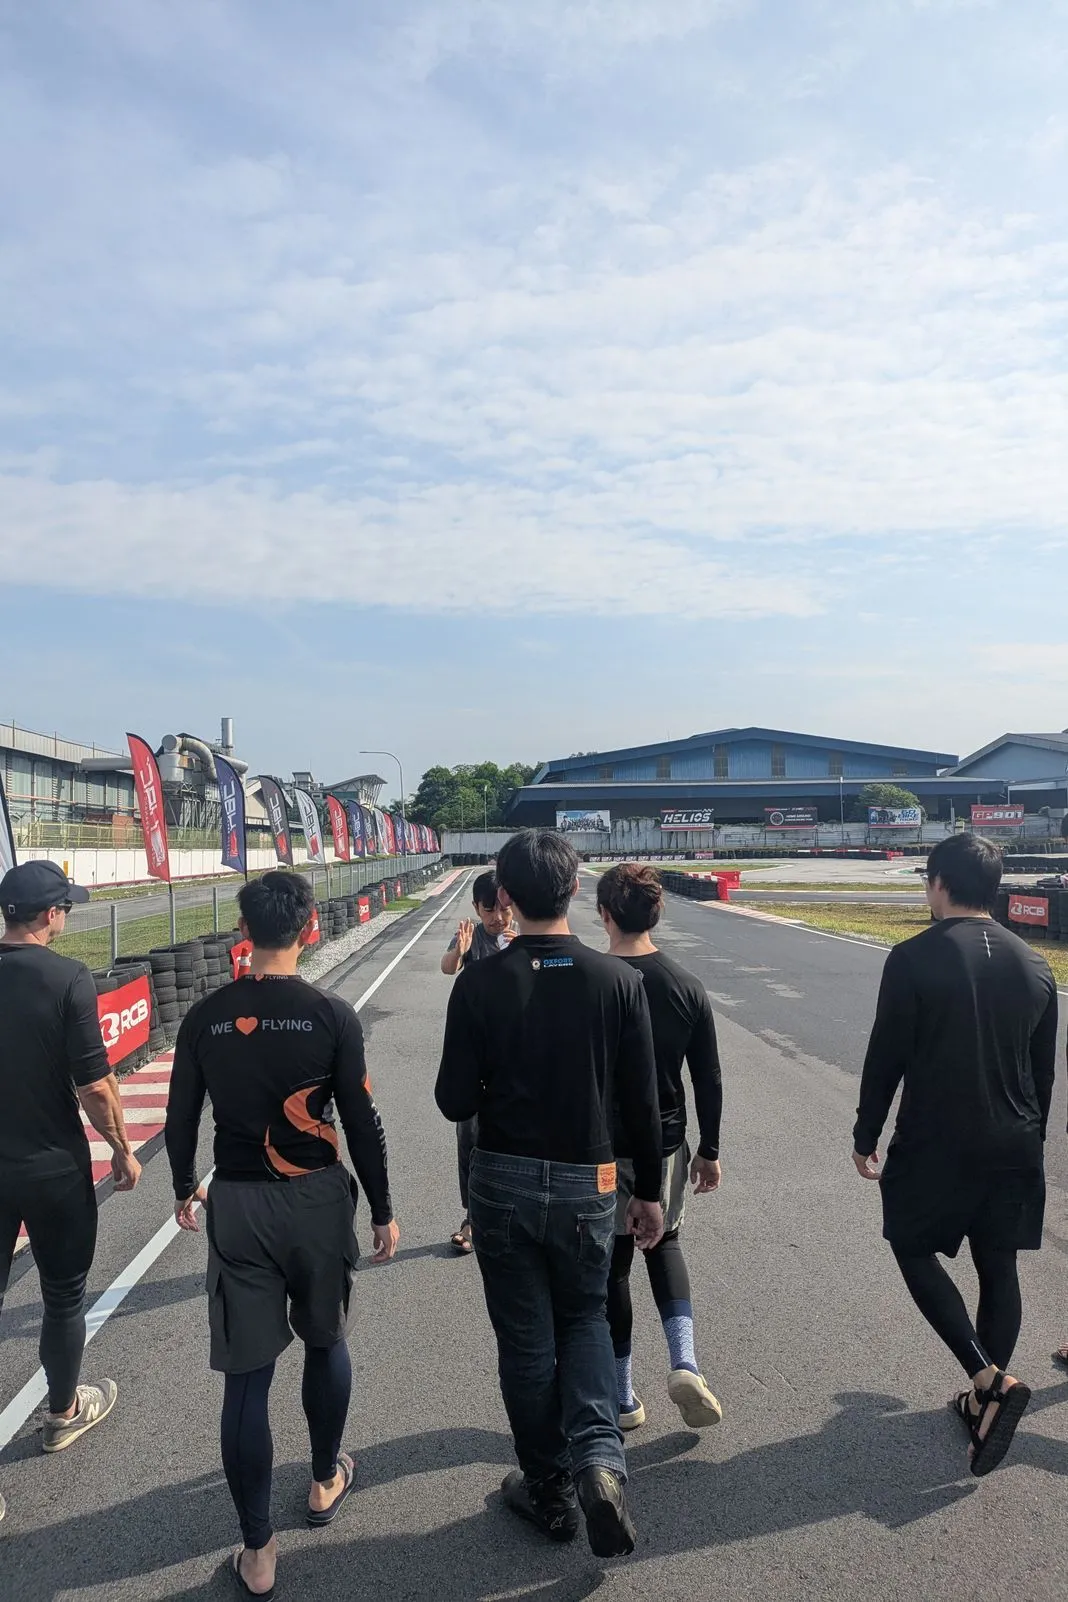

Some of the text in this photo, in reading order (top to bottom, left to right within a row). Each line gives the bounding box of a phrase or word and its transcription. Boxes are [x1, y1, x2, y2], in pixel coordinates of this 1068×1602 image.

[663, 813, 711, 823] HELIOS
[972, 810, 1022, 820] GP901
[1023, 905, 1045, 916] RCB
[120, 998, 148, 1035] RCB
[211, 1020, 313, 1035] WE FLYING
